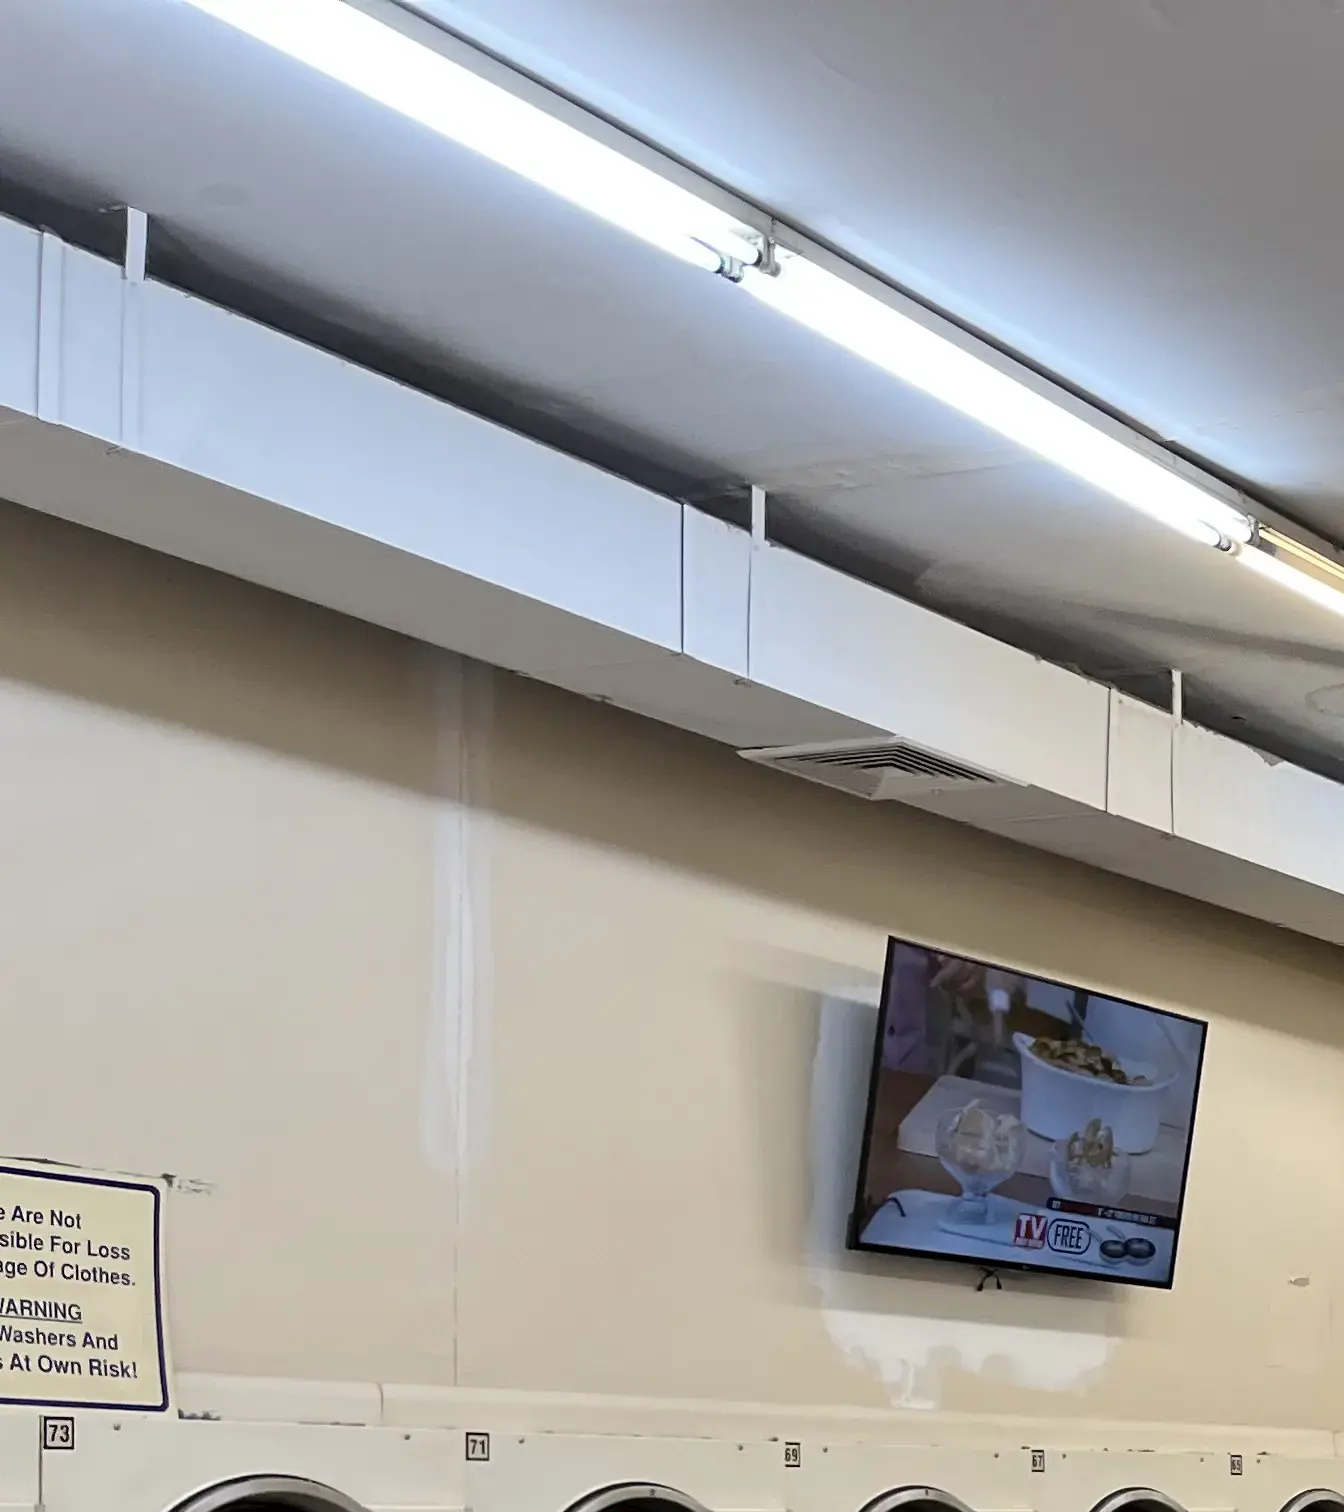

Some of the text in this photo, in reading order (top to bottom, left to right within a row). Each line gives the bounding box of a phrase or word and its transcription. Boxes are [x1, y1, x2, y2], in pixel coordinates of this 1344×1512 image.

[11, 1205, 44, 1225] Are
[50, 1209, 82, 1230] Not
[1017, 1214, 1085, 1250] TV FREE
[50, 1235, 81, 1255] For
[87, 1239, 131, 1261] Loss
[34, 1260, 55, 1278] Of
[61, 1263, 136, 1287] Clothes.
[82, 1333, 119, 1351] And
[10, 1353, 32, 1372] At
[37, 1354, 83, 1376] Own
[89, 1359, 138, 1379] Risk!
[48, 1424, 70, 1443] 73
[470, 1439, 486, 1455] 71
[785, 1448, 798, 1461] 69
[1031, 1455, 1042, 1467] 67
